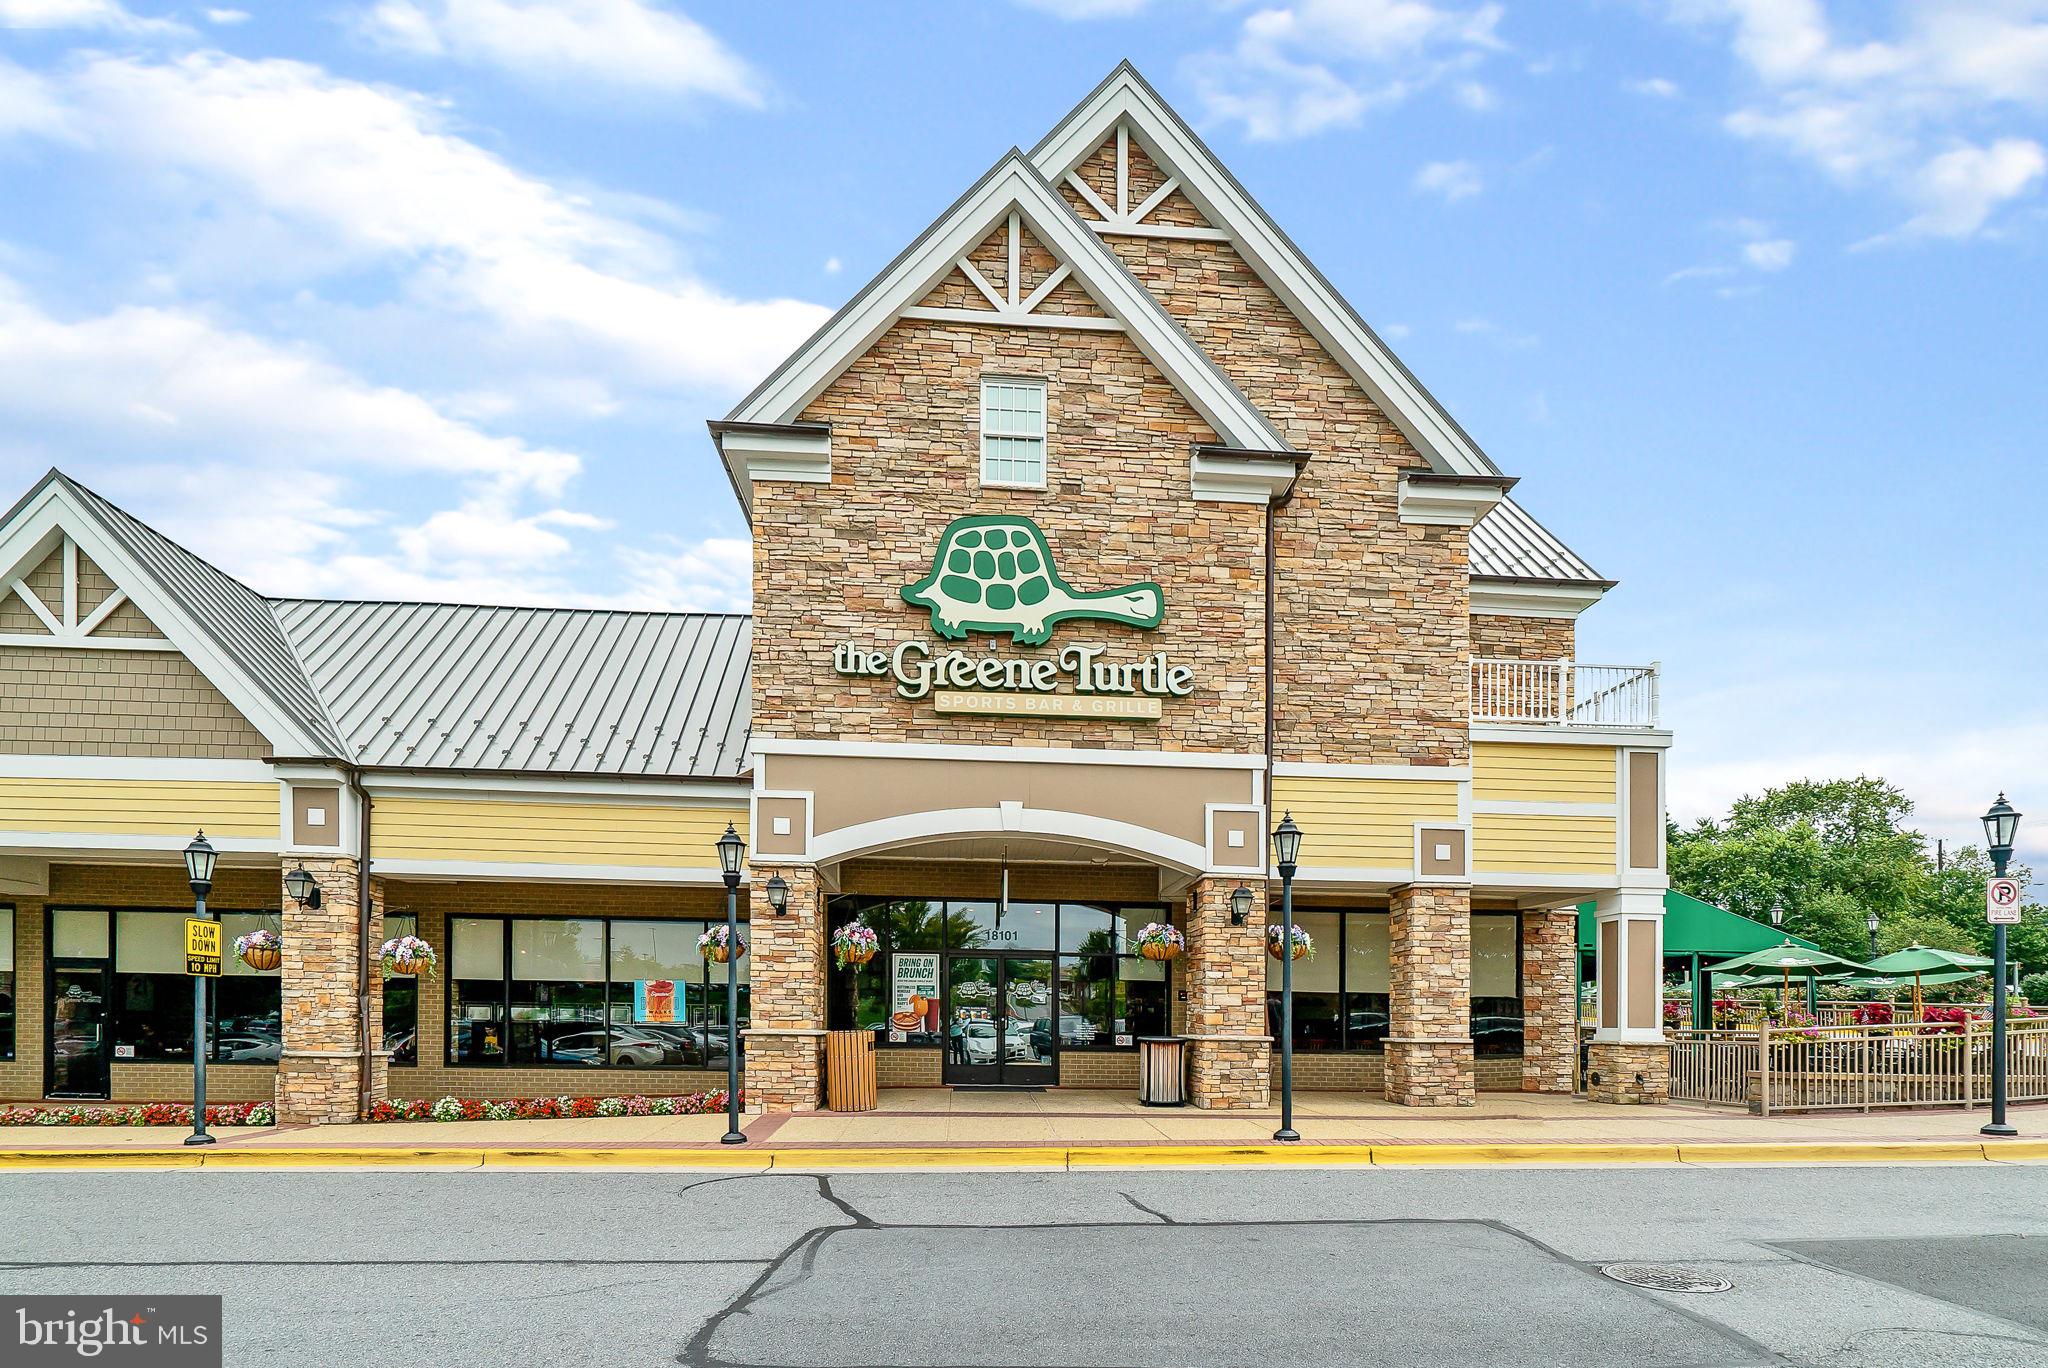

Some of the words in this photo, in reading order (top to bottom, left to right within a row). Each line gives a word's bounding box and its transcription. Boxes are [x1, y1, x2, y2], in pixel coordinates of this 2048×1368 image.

[831, 640, 888, 675] the
[892, 640, 1059, 698] Greene
[1059, 644, 1195, 696] Turtle
[939, 694, 1017, 710] SPORTS
[1025, 697, 1063, 711] BAR
[1072, 698, 1083, 712] &
[1091, 700, 1158, 714] GRILLE
[192, 925, 216, 938] SLOW
[985, 930, 1018, 941] 18101
[192, 939, 216, 952] DOWN
[191, 962, 201, 972] 10
[203, 963, 217, 973] MPH
[898, 957, 922, 968] BRING
[922, 958, 934, 968] ON
[897, 968, 934, 979] BRUNCH
